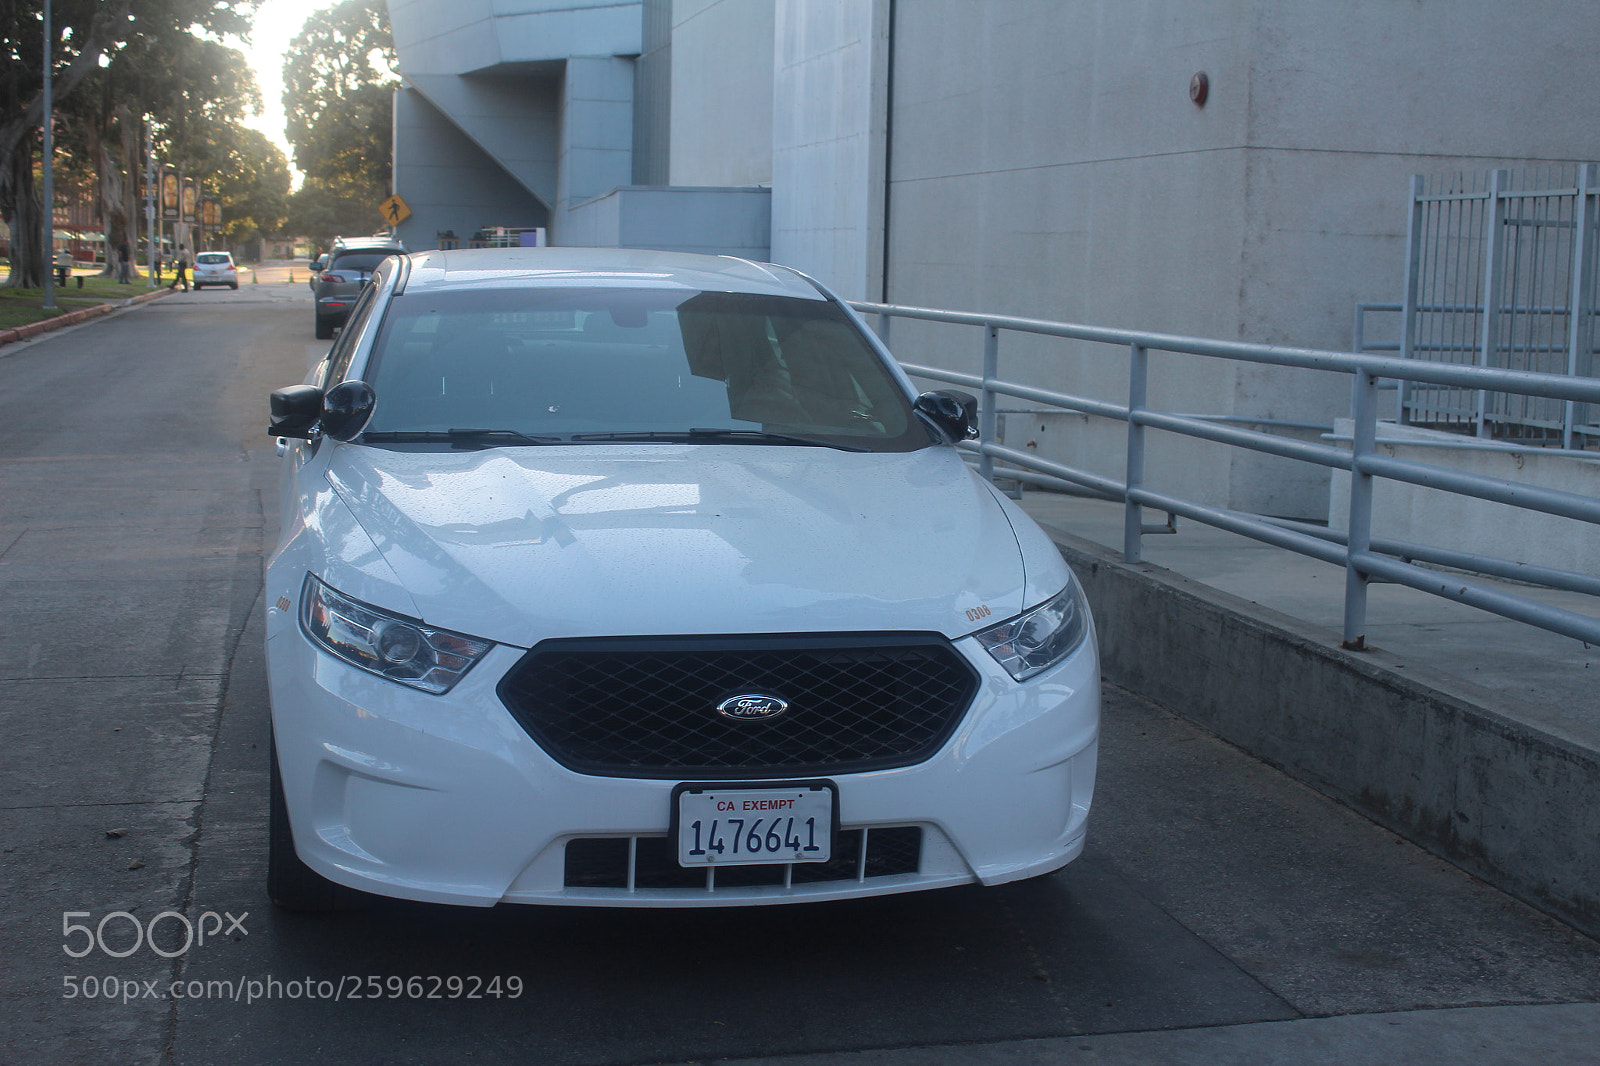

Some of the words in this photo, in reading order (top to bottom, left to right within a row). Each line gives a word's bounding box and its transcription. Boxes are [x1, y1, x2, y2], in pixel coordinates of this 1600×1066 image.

[965, 604, 991, 621] 0308
[734, 699, 777, 715] Ford
[717, 801, 735, 811] CA
[743, 799, 795, 811] EXEMPT
[689, 817, 820, 855] 1476641
